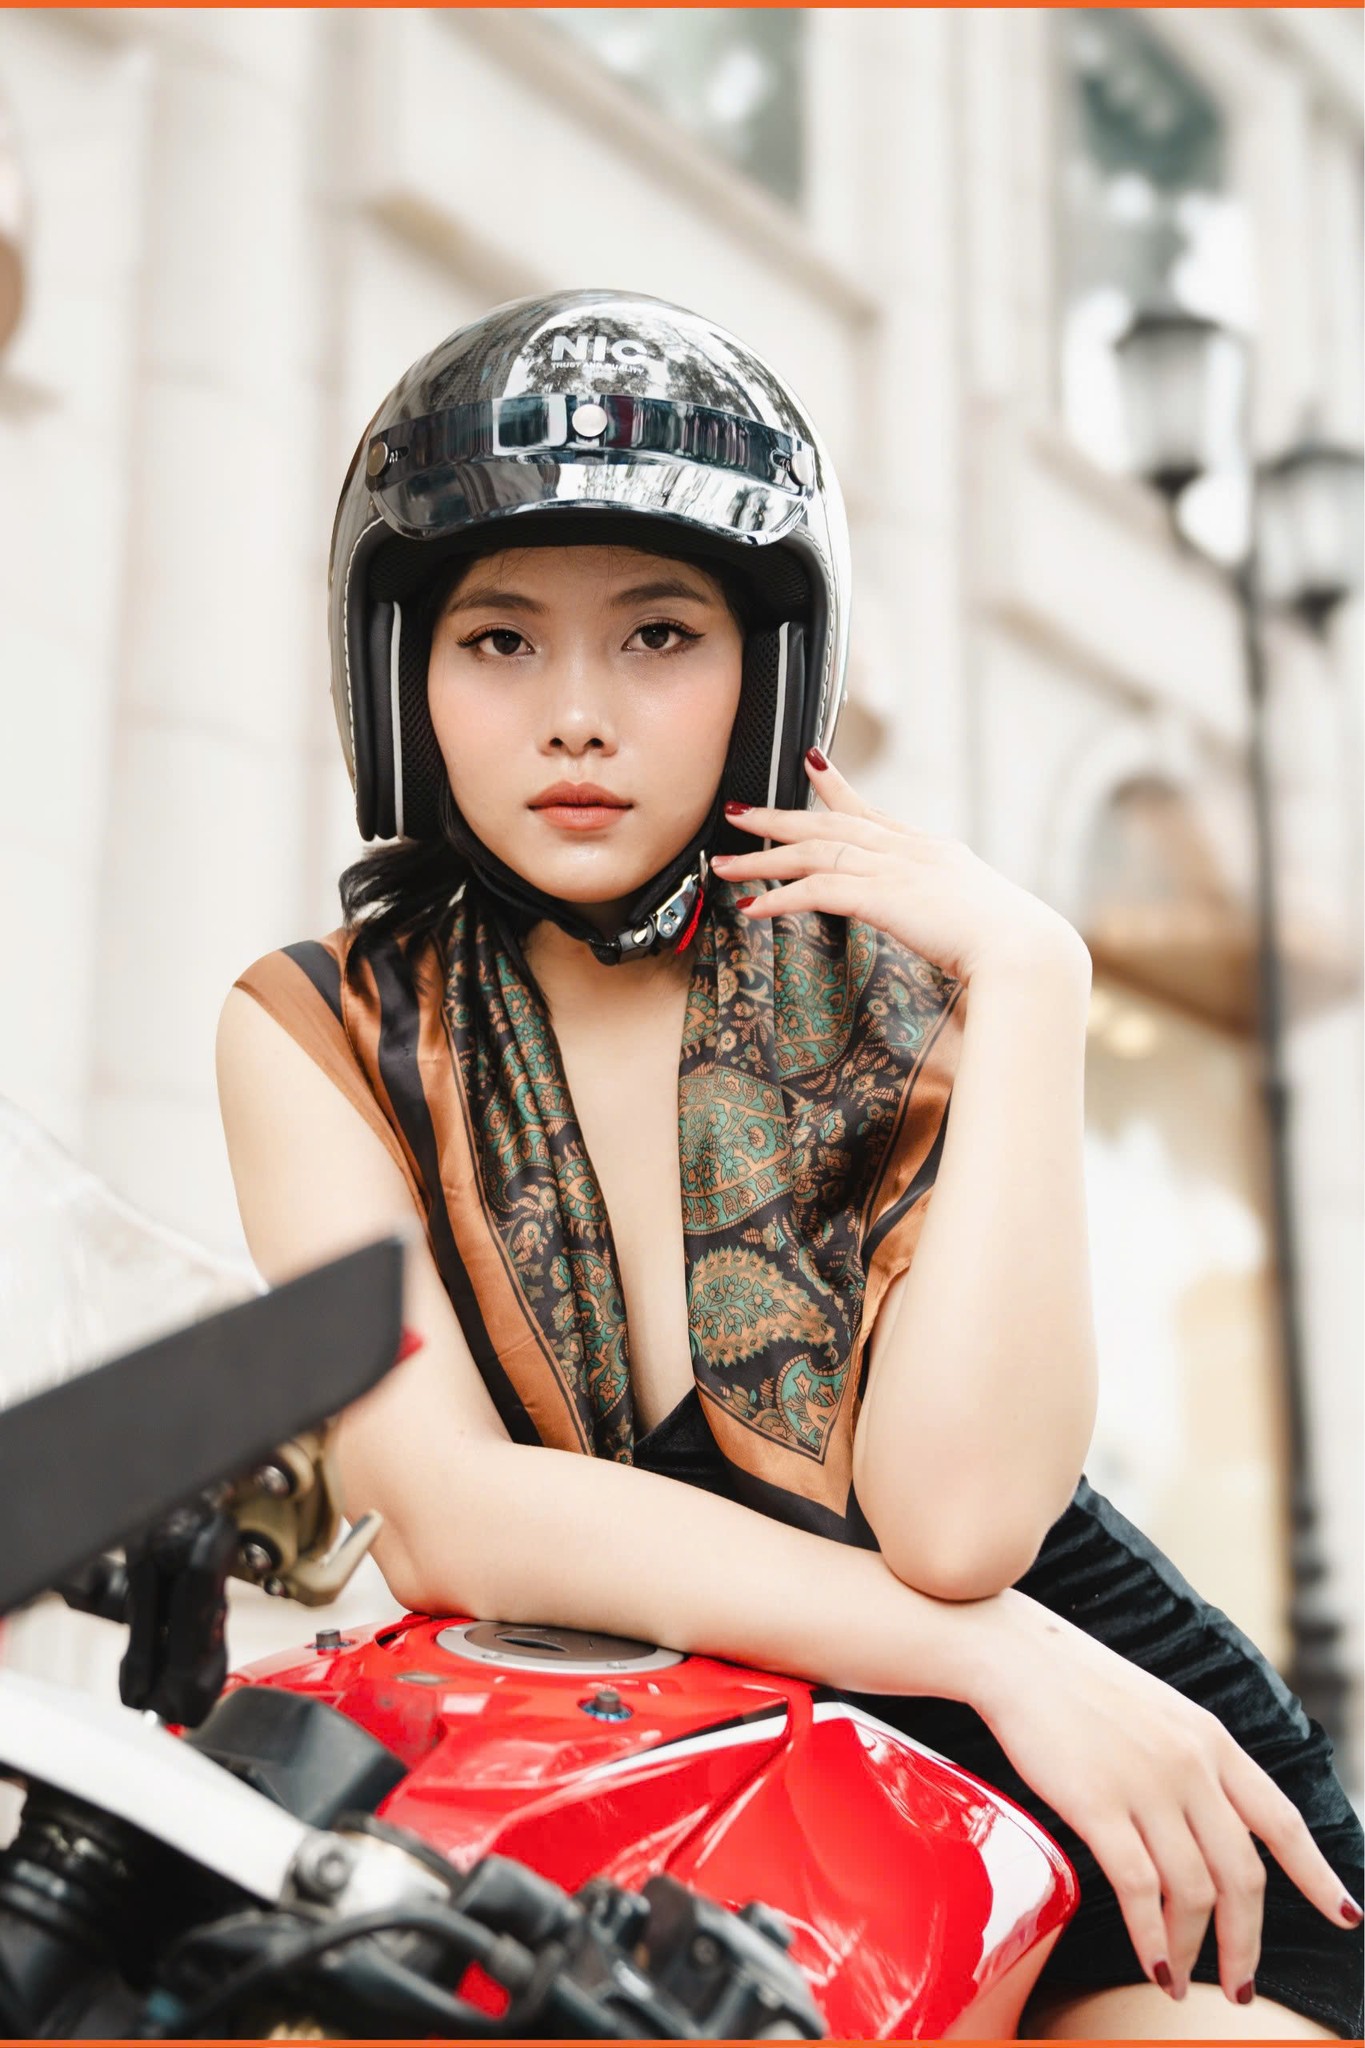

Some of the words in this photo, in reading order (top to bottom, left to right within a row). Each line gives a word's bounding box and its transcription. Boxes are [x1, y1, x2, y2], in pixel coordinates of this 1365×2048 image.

[551, 335, 648, 365] NIC
[582, 362, 603, 370] AND
[605, 363, 645, 374] QUALITY
